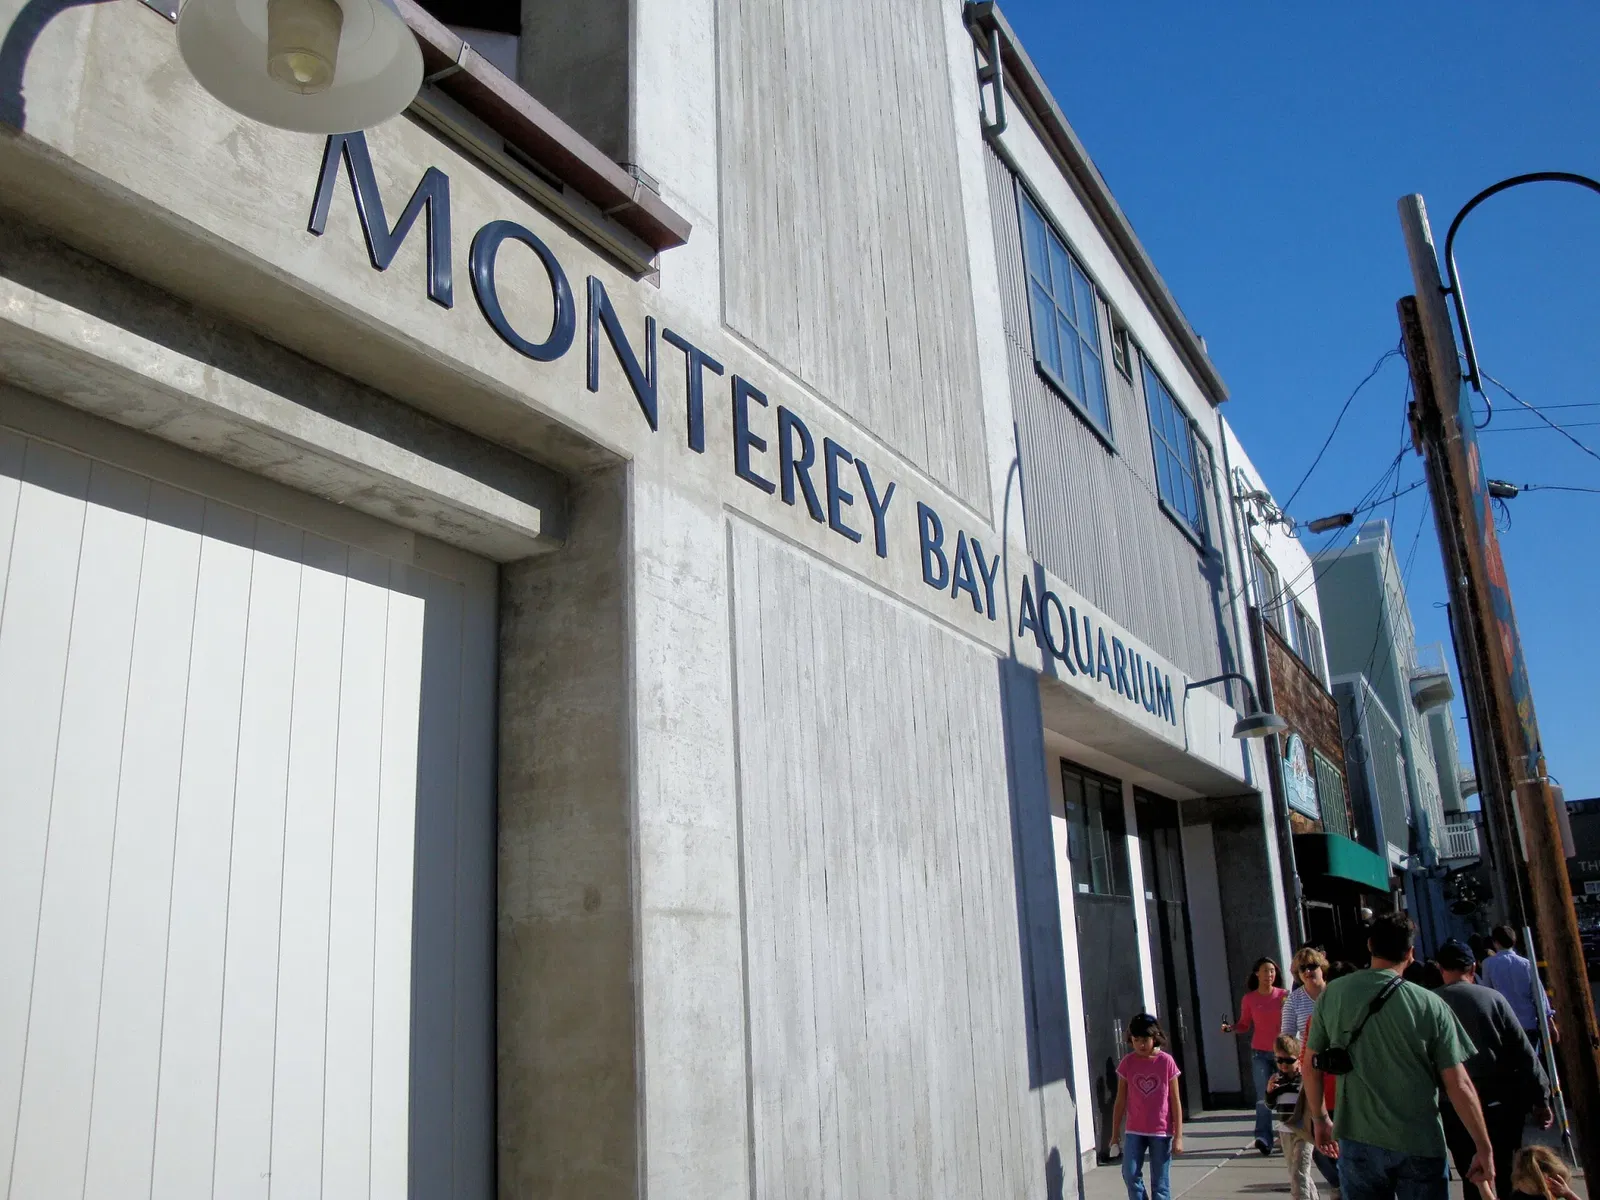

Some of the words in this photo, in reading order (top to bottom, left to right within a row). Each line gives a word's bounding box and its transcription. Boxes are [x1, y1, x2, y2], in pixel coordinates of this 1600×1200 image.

[307, 130, 896, 559] MONTEREY
[916, 500, 1001, 621] BAY
[1018, 574, 1177, 727] AQUARIUM
